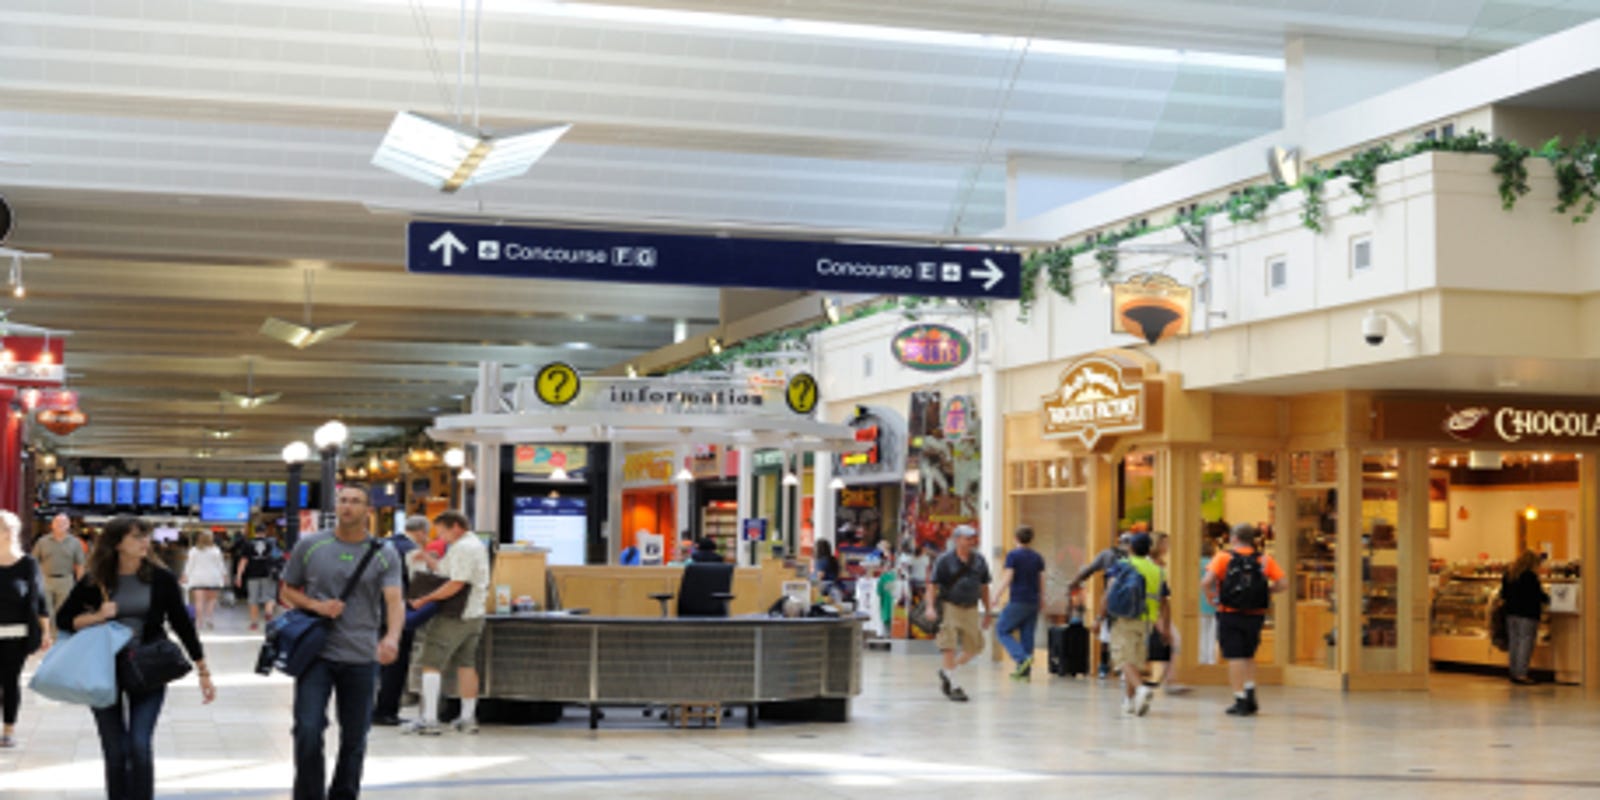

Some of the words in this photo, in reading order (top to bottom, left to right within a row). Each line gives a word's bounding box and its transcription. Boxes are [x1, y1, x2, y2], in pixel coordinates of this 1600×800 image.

[505, 243, 608, 263] Concourse
[816, 258, 913, 279] Concourse
[917, 262, 935, 280] E
[609, 385, 763, 406] information
